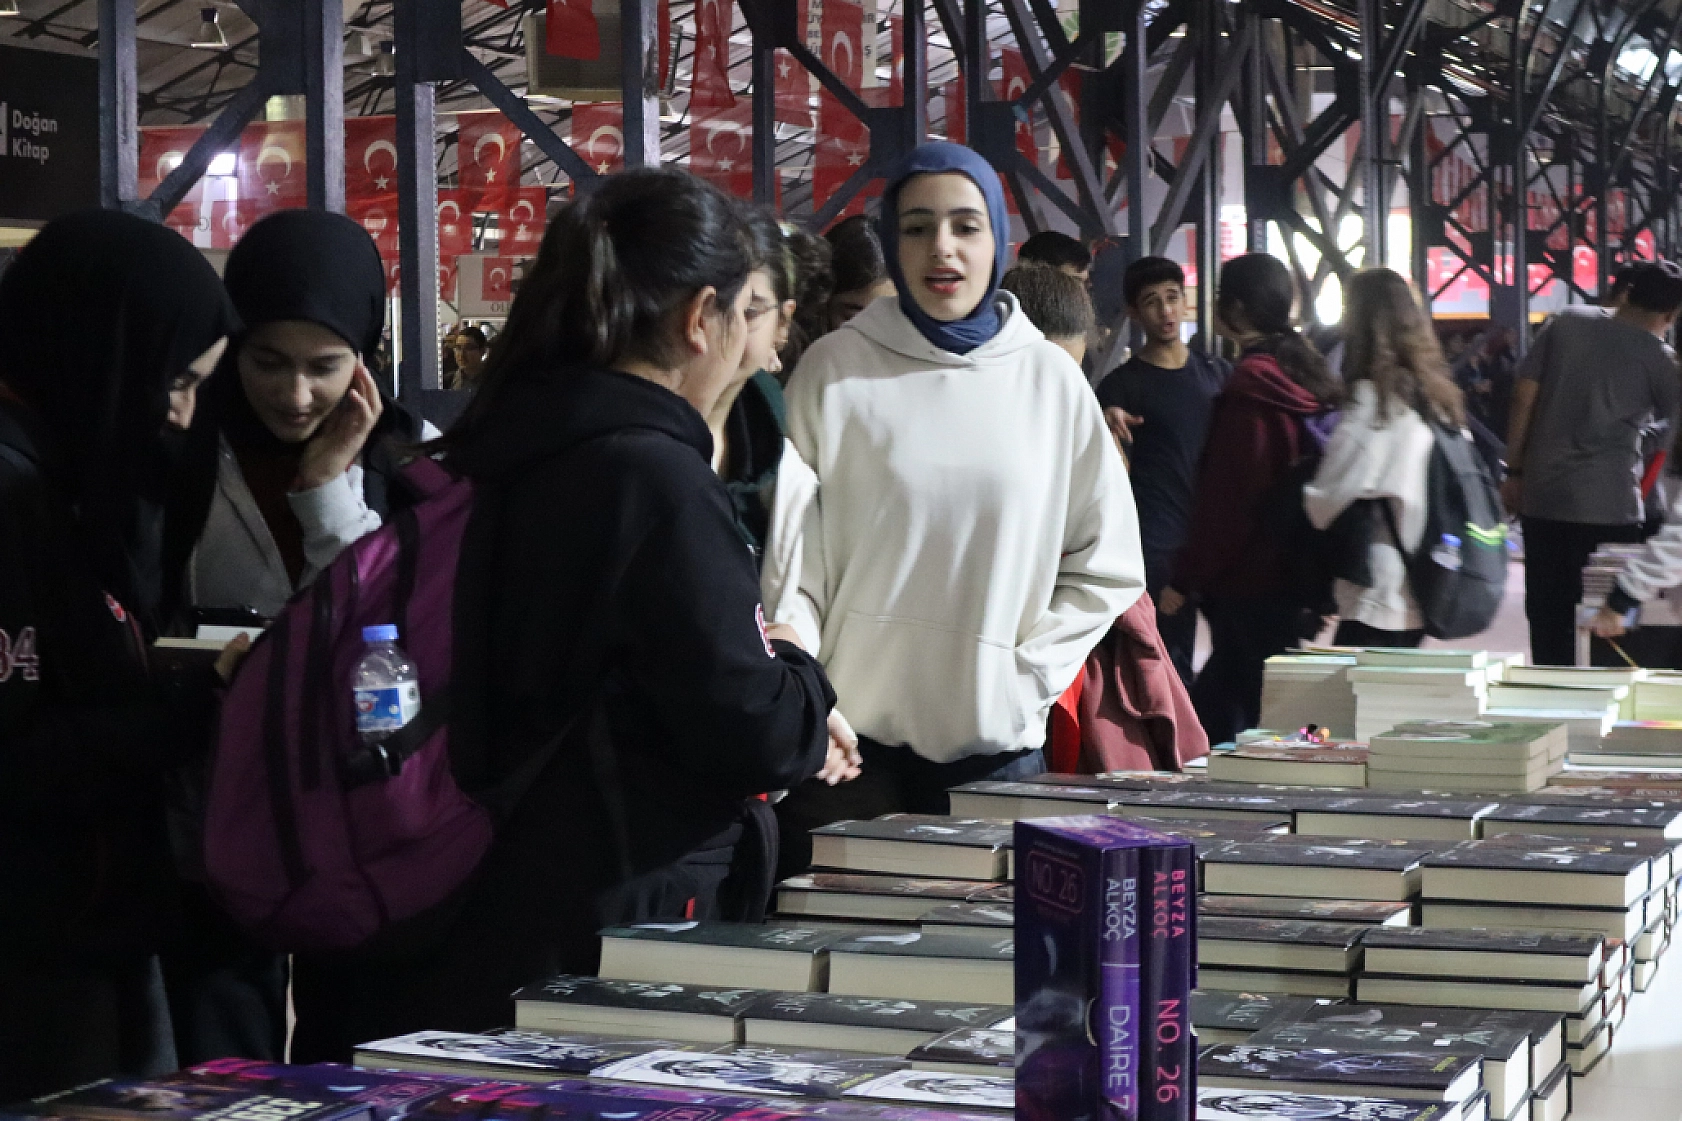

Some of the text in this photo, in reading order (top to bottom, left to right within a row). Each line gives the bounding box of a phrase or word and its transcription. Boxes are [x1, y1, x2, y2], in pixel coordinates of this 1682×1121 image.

[13, 109, 58, 136] Doğan
[13, 137, 49, 166] Kitap
[1103, 878, 1121, 941] ALKOÇ
[1122, 878, 1137, 939] BEYZA
[1171, 869, 1186, 938] BEYZA
[1157, 999, 1181, 1103] NO. 26
[1109, 1094, 1129, 1110] 7
